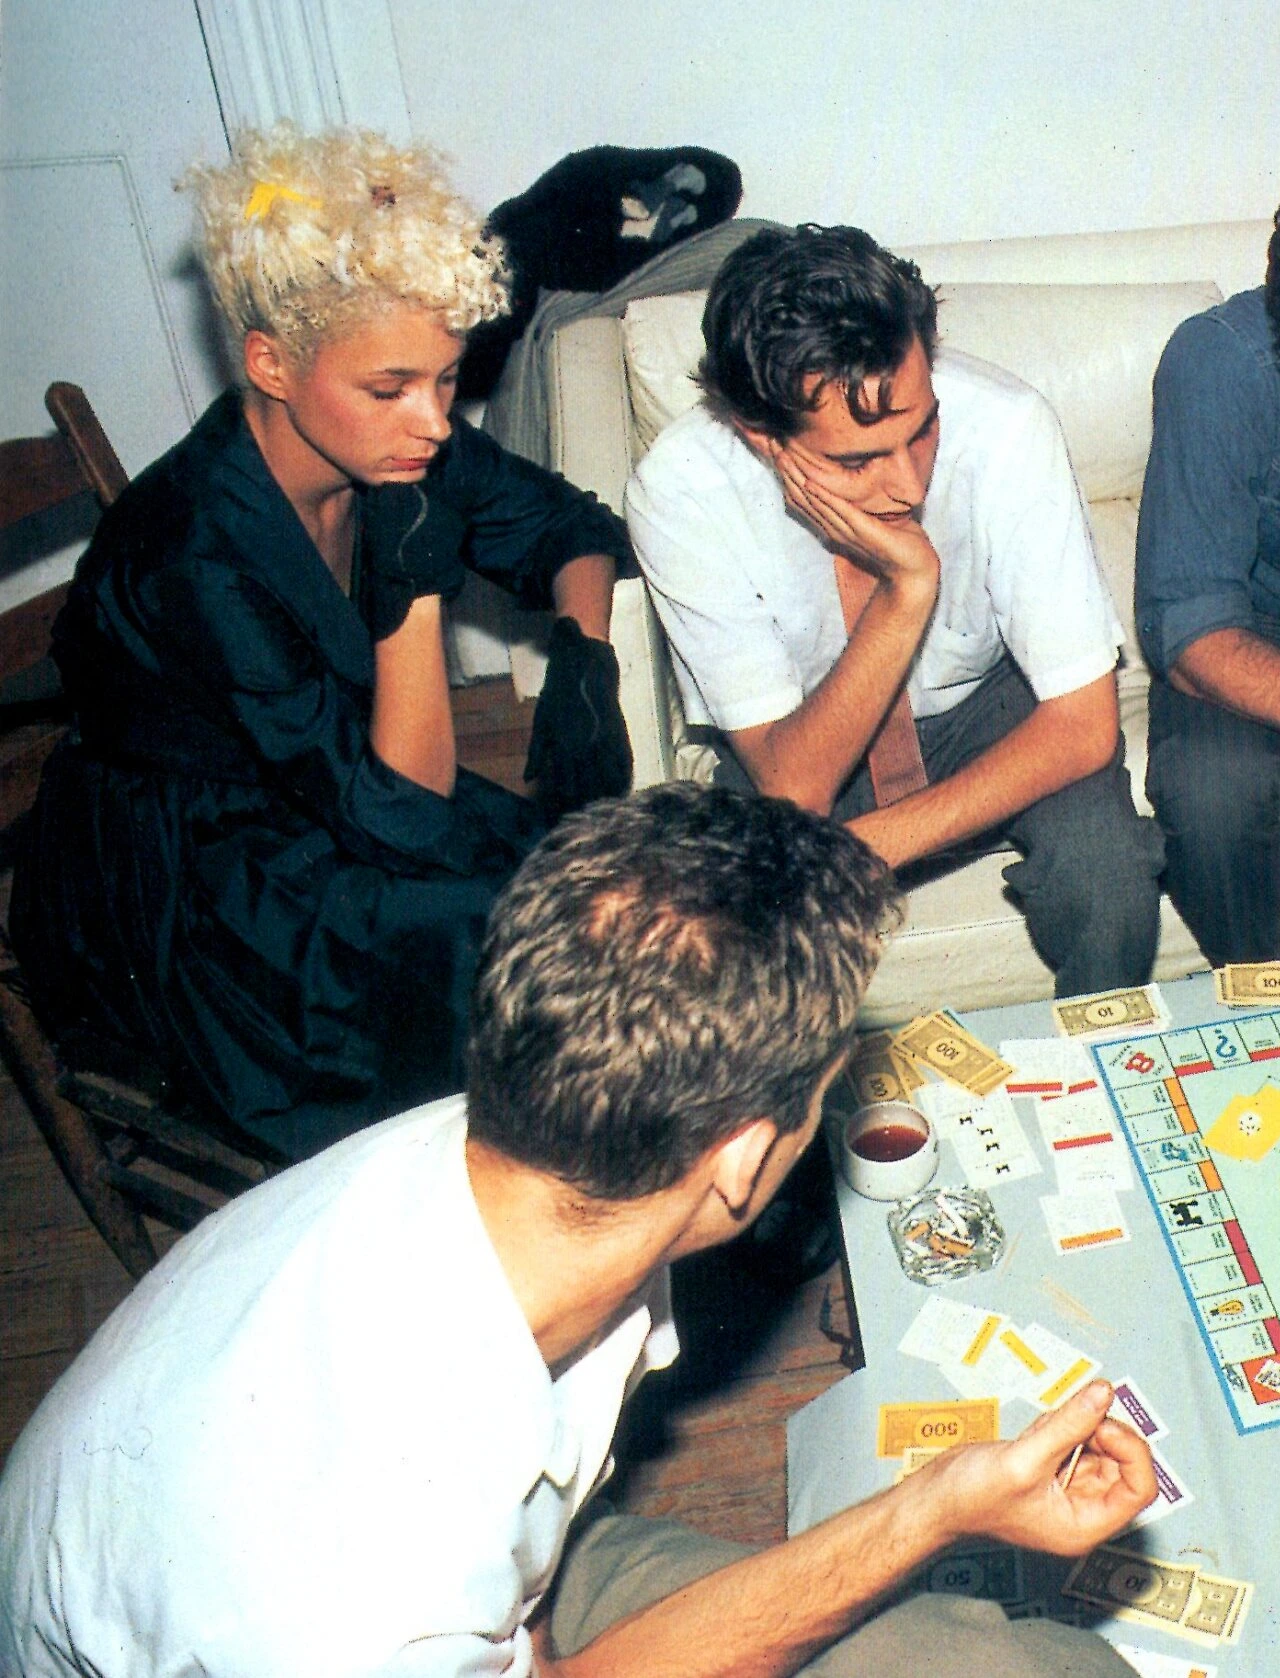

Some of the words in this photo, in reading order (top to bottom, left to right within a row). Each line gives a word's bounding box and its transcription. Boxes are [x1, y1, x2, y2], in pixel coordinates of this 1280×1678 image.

[1098, 1007, 1114, 1018] 10
[936, 1042, 960, 1060] 100
[921, 1422, 958, 1438] 500
[945, 1569, 971, 1587] 50
[1125, 1576, 1148, 1593] 10
